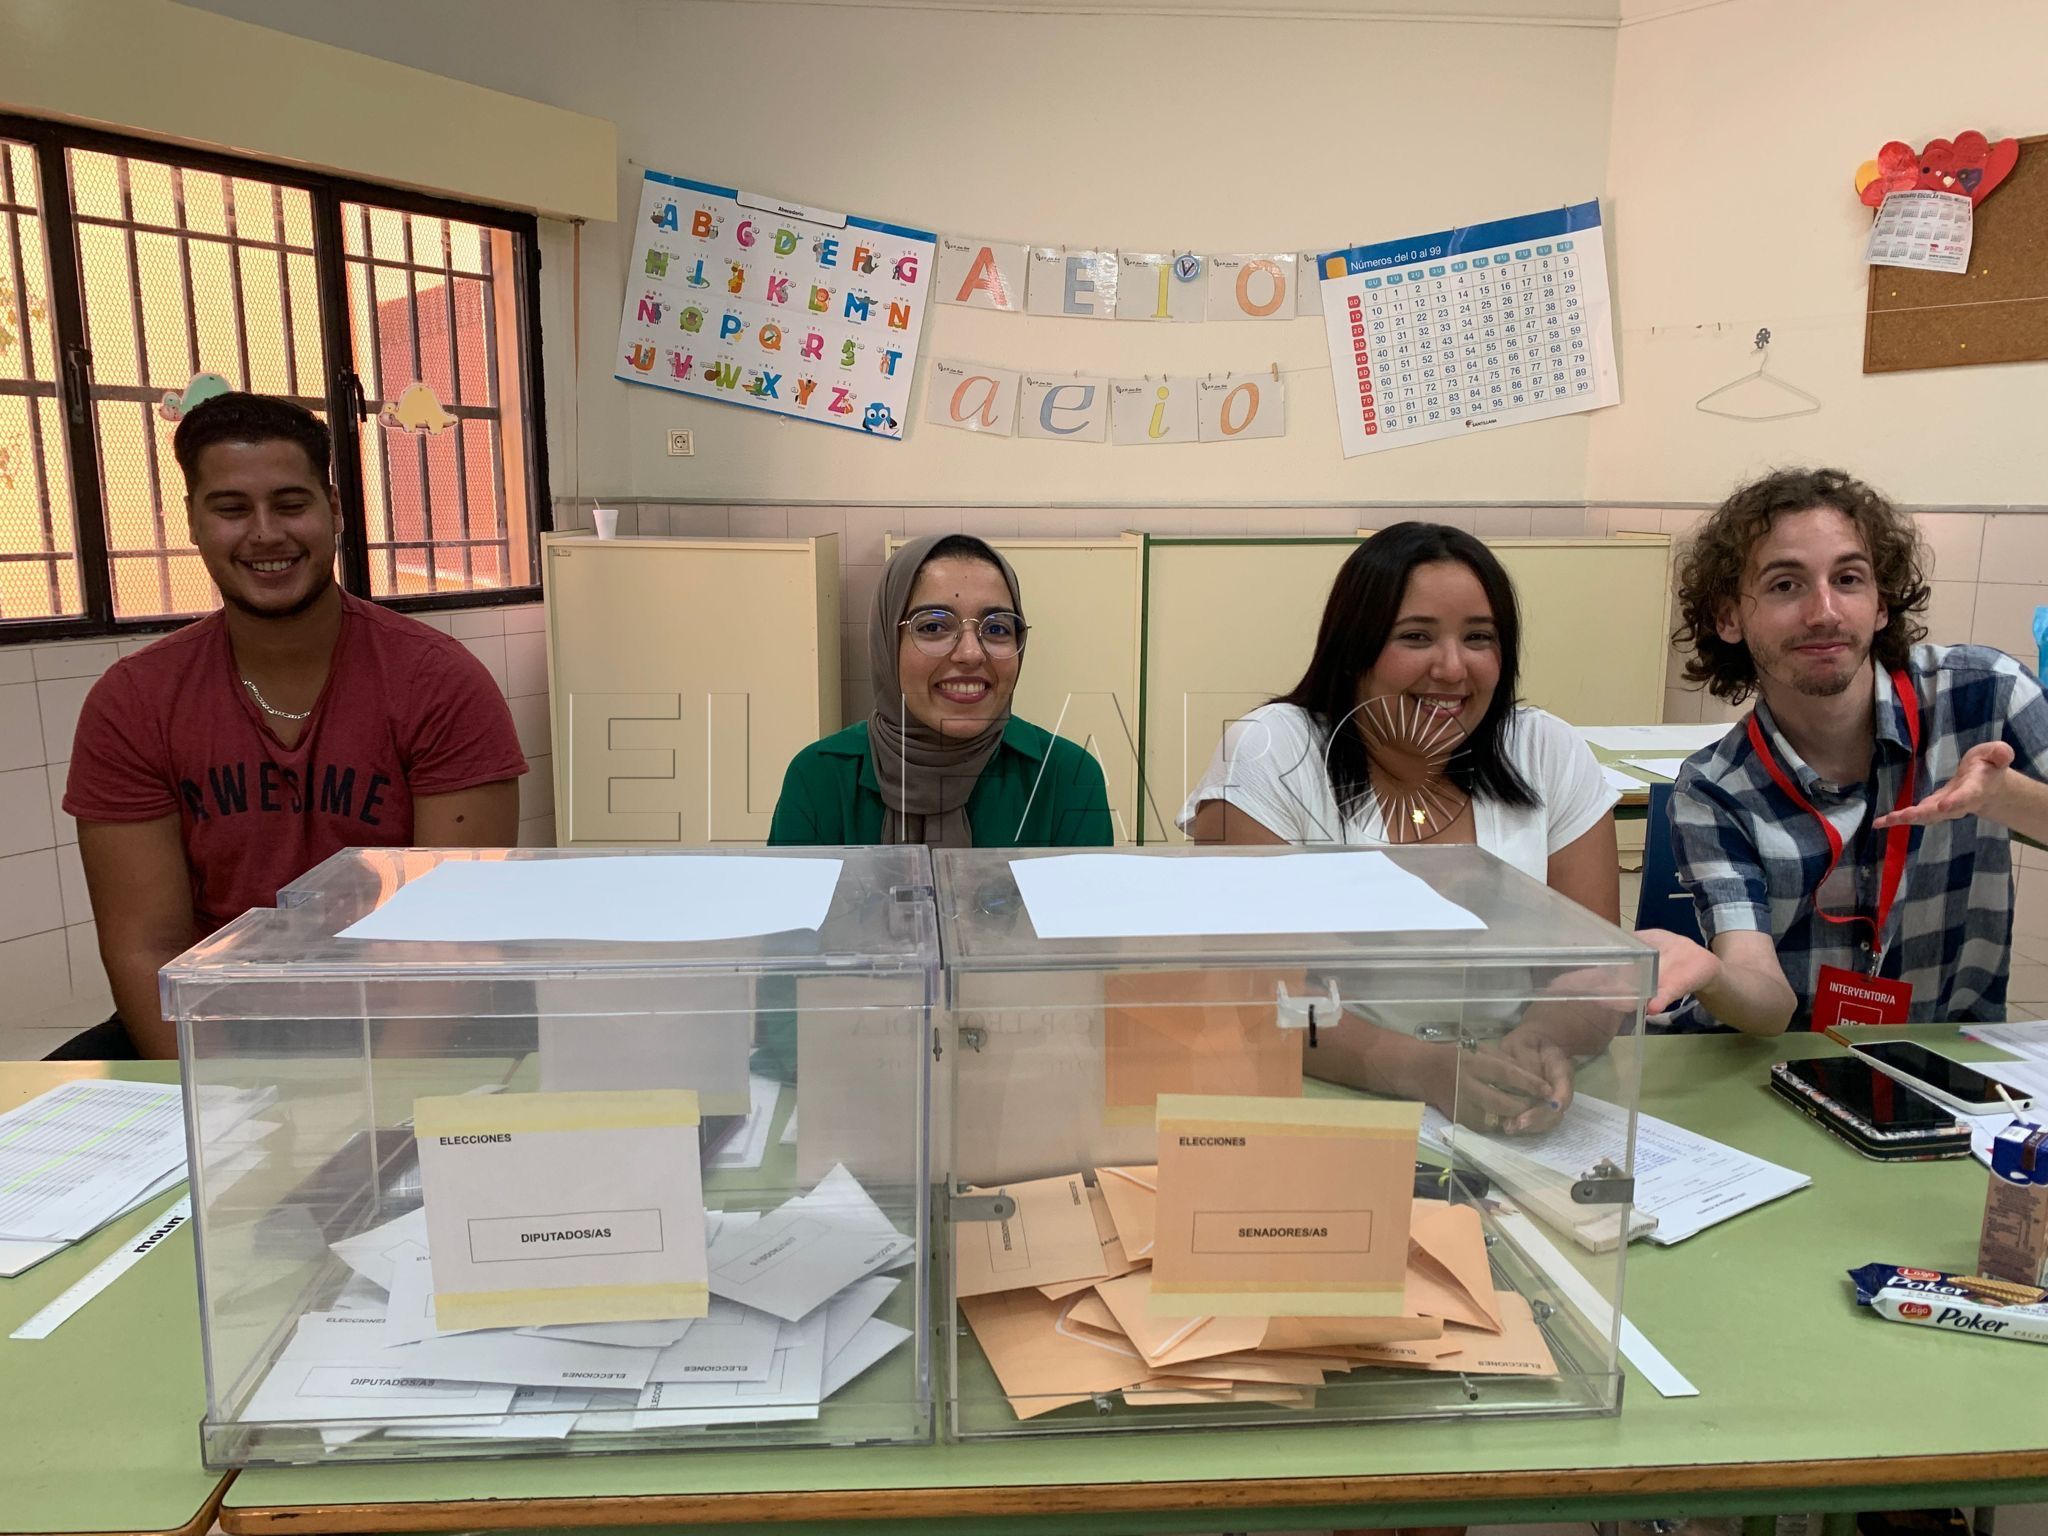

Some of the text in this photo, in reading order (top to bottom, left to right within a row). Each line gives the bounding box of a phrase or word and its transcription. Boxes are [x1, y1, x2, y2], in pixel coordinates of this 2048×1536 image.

[658, 204, 678, 231] A
[691, 210, 712, 238] B
[774, 228, 797, 255] D
[820, 239, 839, 266] E
[852, 246, 870, 272] F
[899, 257, 918, 284] G
[1350, 245, 1442, 271] Números del 0 al 99
[694, 259, 704, 285] I
[767, 276, 789, 304] K
[844, 293, 869, 321] M
[888, 302, 911, 330] N
[955, 246, 1008, 306] A
[1063, 256, 1097, 315] E
[1150, 263, 1175, 318] I
[1235, 259, 1286, 316] O
[1372, 293, 1378, 301] 0
[1415, 285, 1421, 293] 2
[1436, 281, 1442, 289] 3
[1480, 272, 1485, 280] 5
[1501, 268, 1507, 276] 6
[1522, 264, 1527, 272] 7
[1543, 260, 1548, 268] 8
[1563, 256, 1569, 264] 9
[1372, 270, 1574, 315] 10 11 12 13 14 15 16 17 18 19
[1373, 284, 1576, 330] 20 21 22 23 24 25 26 27 28 29
[1375, 298, 1577, 344] 30 31 32 33 34 35 36 37 38 39
[637, 294, 902, 376] Ñ O P Q R T
[1377, 312, 1579, 358] 40 41 42 43 44 45 46 47 48 49
[1379, 326, 1581, 372] 50 51 52 53 54 55 56 57 58 59
[633, 344, 849, 414] U V W X Y Z
[1381, 340, 1583, 386] 60 61 62 63 64 65 66 67 68 69
[1383, 354, 1585, 400] 70 71 72 73 74 75 76 77 78 79
[950, 375, 1001, 427] a
[1039, 385, 1095, 434] e
[1148, 386, 1170, 439] i
[1220, 382, 1260, 436] o
[1386, 382, 1588, 428] 90 91 92 93 94 95 96 97 98 99
[1829, 981, 1896, 1005] INTERVENTOR/A
[439, 1133, 512, 1146] ELECCIONES
[1179, 1137, 1246, 1146] ELECCIONES
[521, 1228, 612, 1243] DIPUTADOS/AS
[1238, 1228, 1328, 1238] SENADORES/AS
[1886, 1276, 1969, 1296] Poker
[1902, 1303, 1929, 1315] Lago
[1936, 1307, 2010, 1333] Poker
[350, 1377, 436, 1387] DIPUTADOS/AS
[561, 1372, 627, 1380] ELECCIONES
[683, 1365, 749, 1373] ELECCIONES
[1477, 1360, 1541, 1369] ELECCIONES
